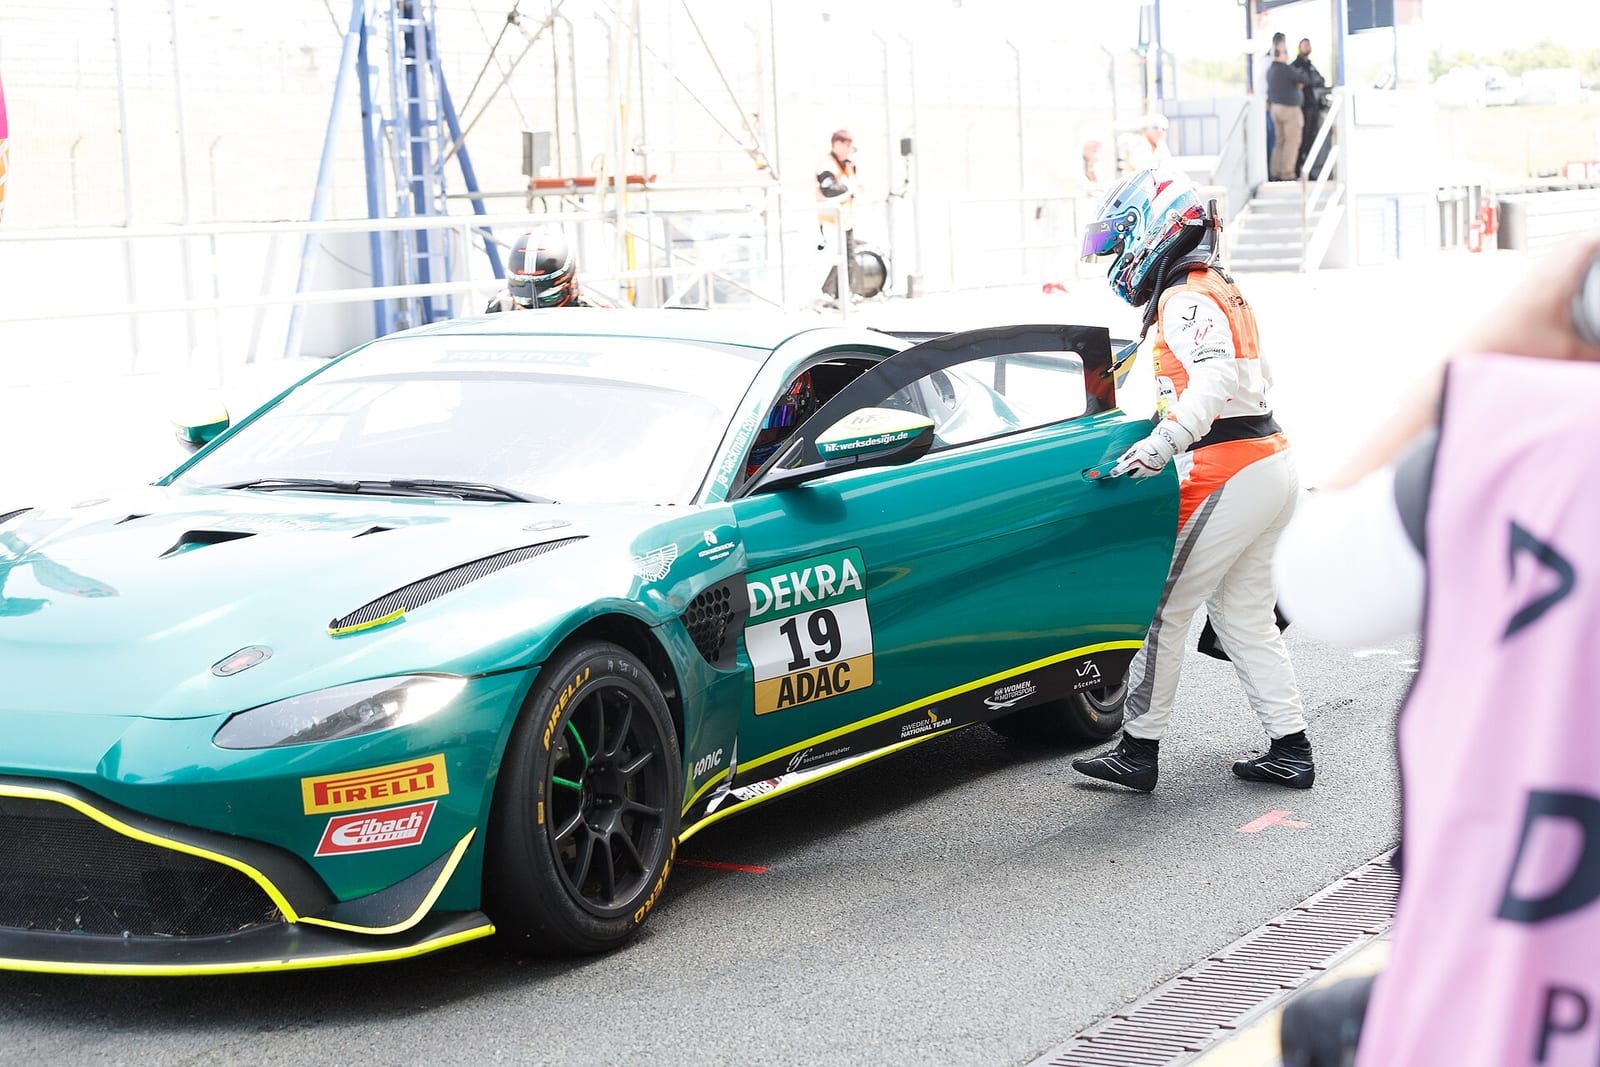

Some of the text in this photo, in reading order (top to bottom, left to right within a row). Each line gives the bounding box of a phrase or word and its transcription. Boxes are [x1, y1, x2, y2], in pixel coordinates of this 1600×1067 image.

[746, 558, 863, 618] DEKRA
[779, 608, 842, 672] 19
[776, 661, 851, 709] ADAC
[999, 685, 1037, 702] MOTORSPORT
[1003, 680, 1031, 694] WOMEN
[543, 667, 591, 751] PIRELLI
[900, 718, 952, 738] NATIONAL TEAM
[901, 718, 931, 732] SWEDEN
[313, 762, 435, 806] PIRELLI
[331, 811, 423, 847] Eibach
